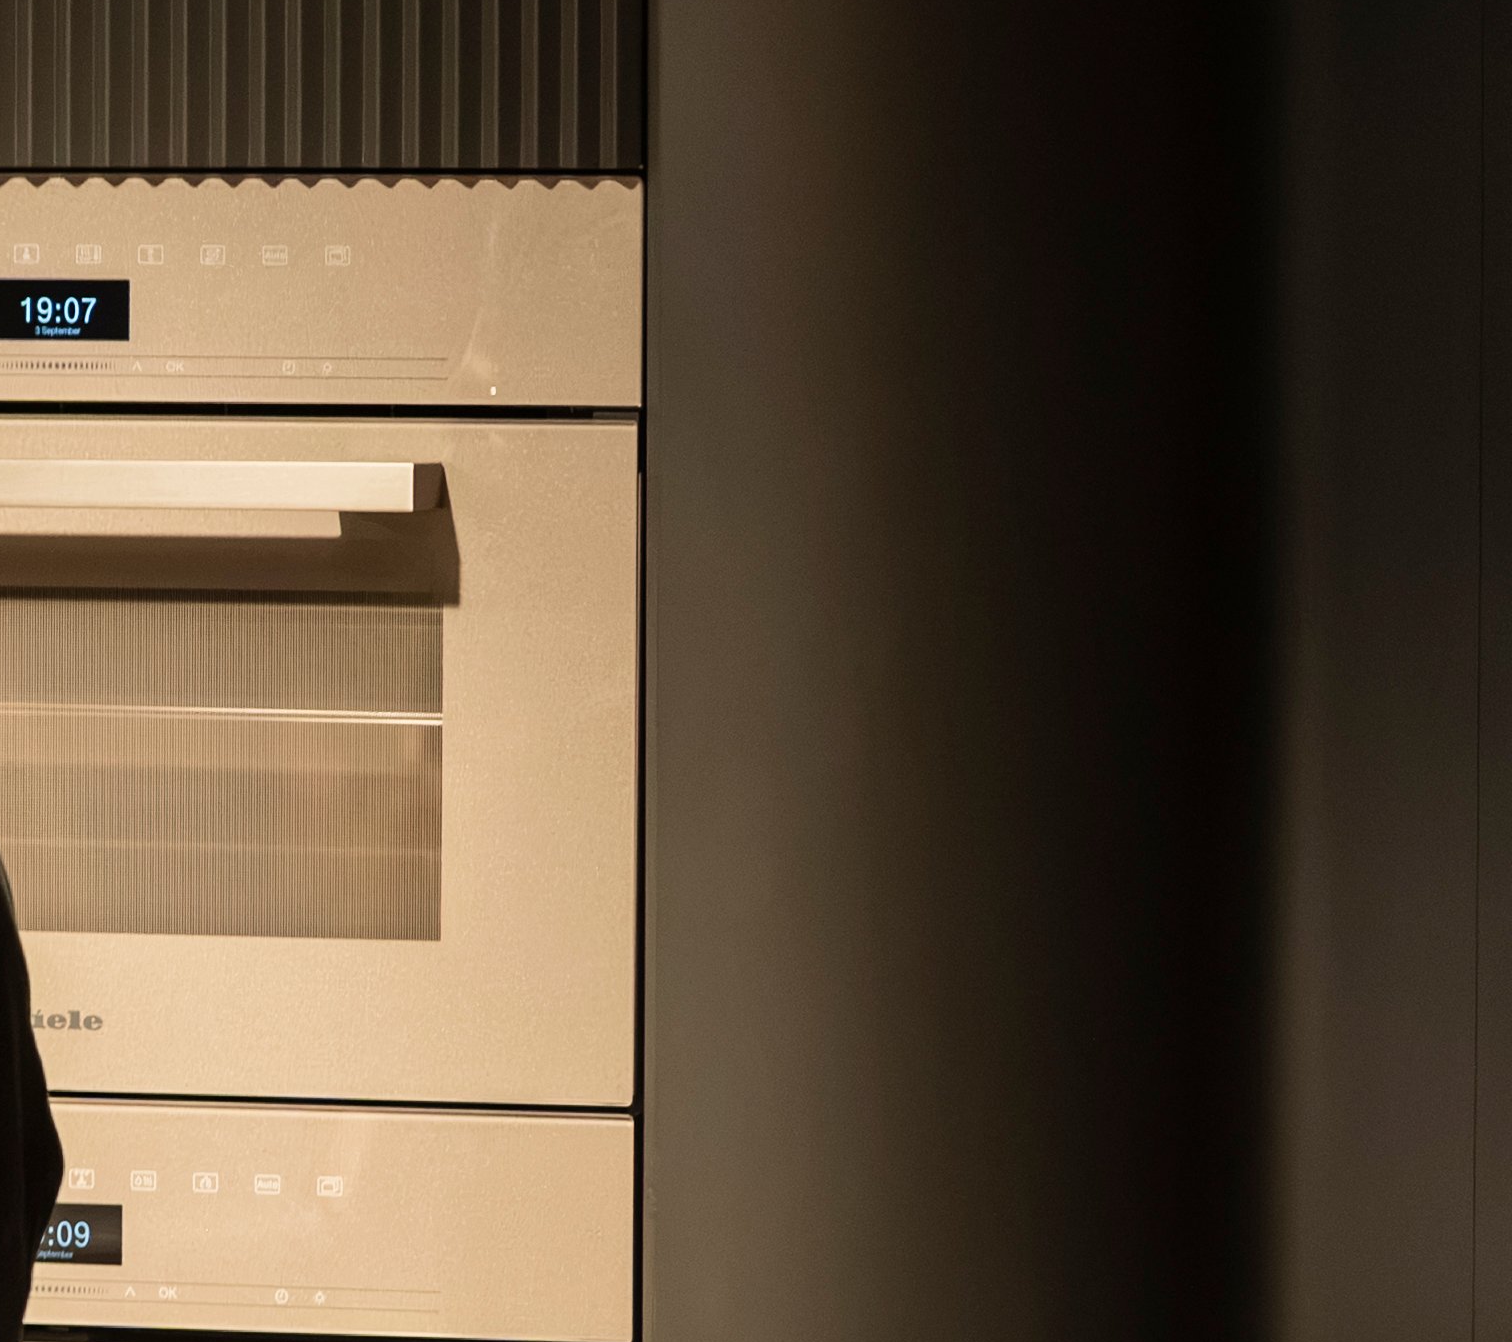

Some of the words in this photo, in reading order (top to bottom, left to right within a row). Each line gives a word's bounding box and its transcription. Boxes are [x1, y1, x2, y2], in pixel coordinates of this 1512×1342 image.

[20, 296, 97, 324] 19:07
[165, 362, 184, 373] OK
[32, 1009, 103, 1031] iele
[40, 1220, 91, 1248] :09
[158, 1286, 178, 1299] OK
